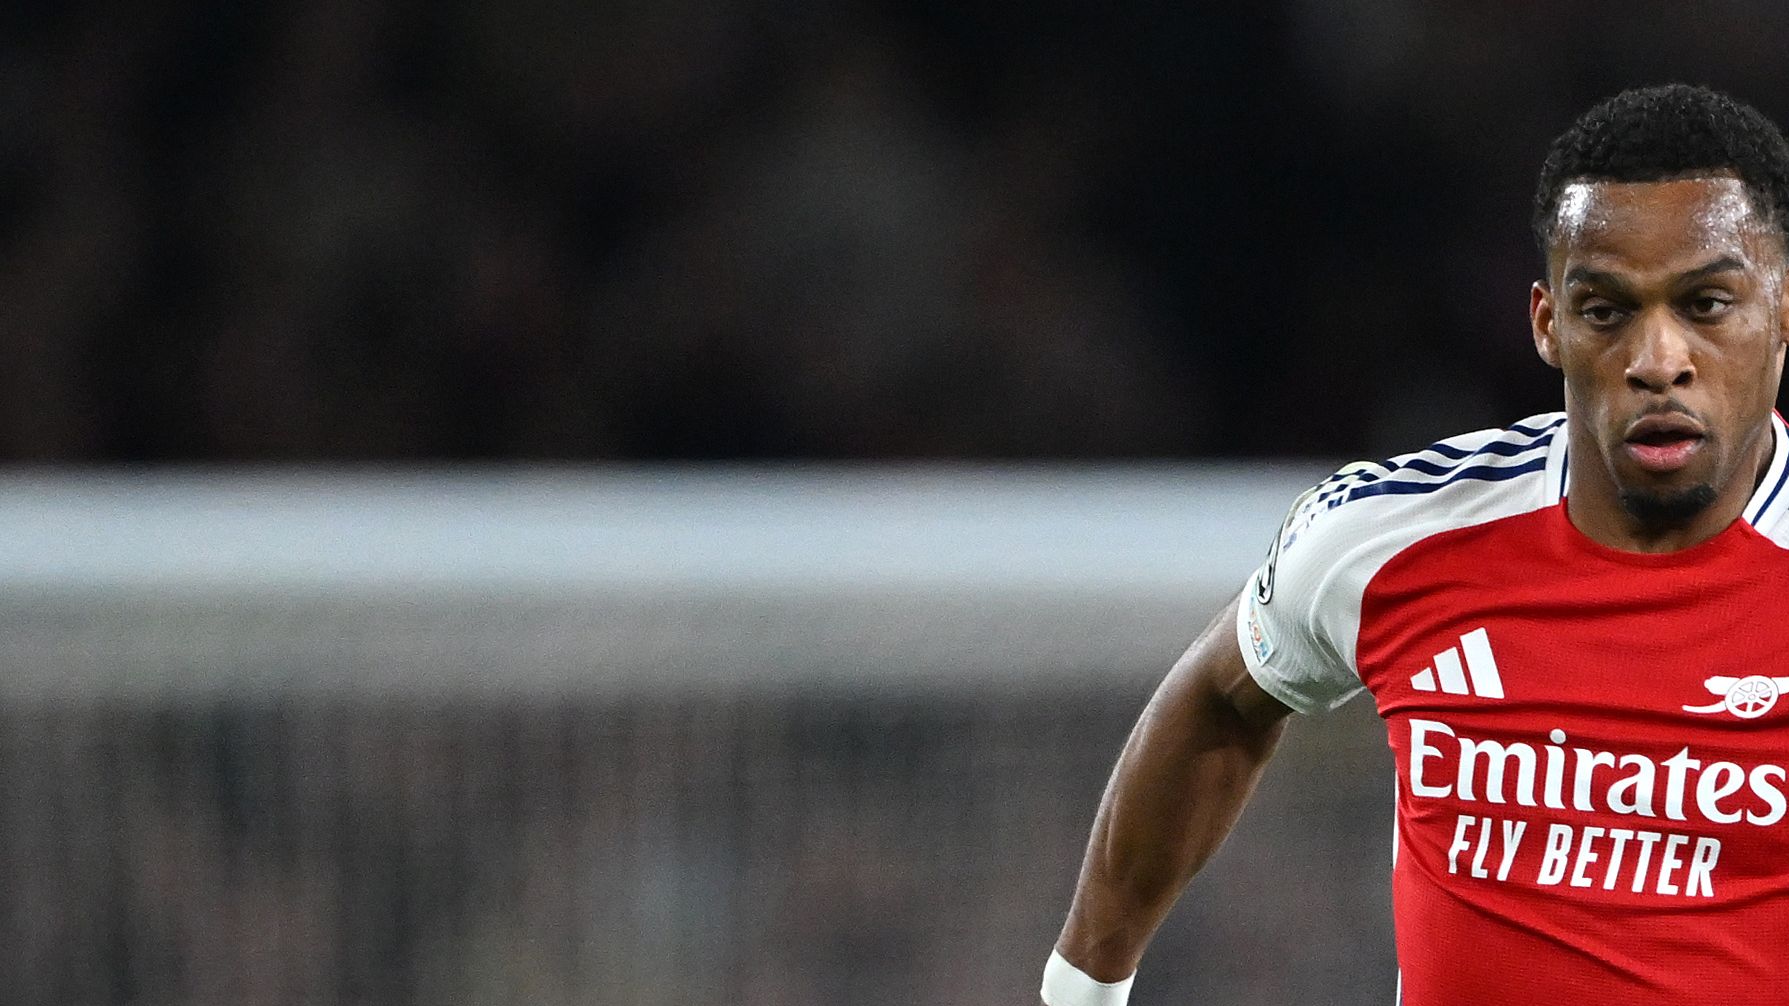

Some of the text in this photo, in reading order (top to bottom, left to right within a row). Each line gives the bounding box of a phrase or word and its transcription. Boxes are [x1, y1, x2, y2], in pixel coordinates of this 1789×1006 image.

[1408, 718, 1788, 827] Emirates
[1447, 814, 1722, 898] FLY BETTER
